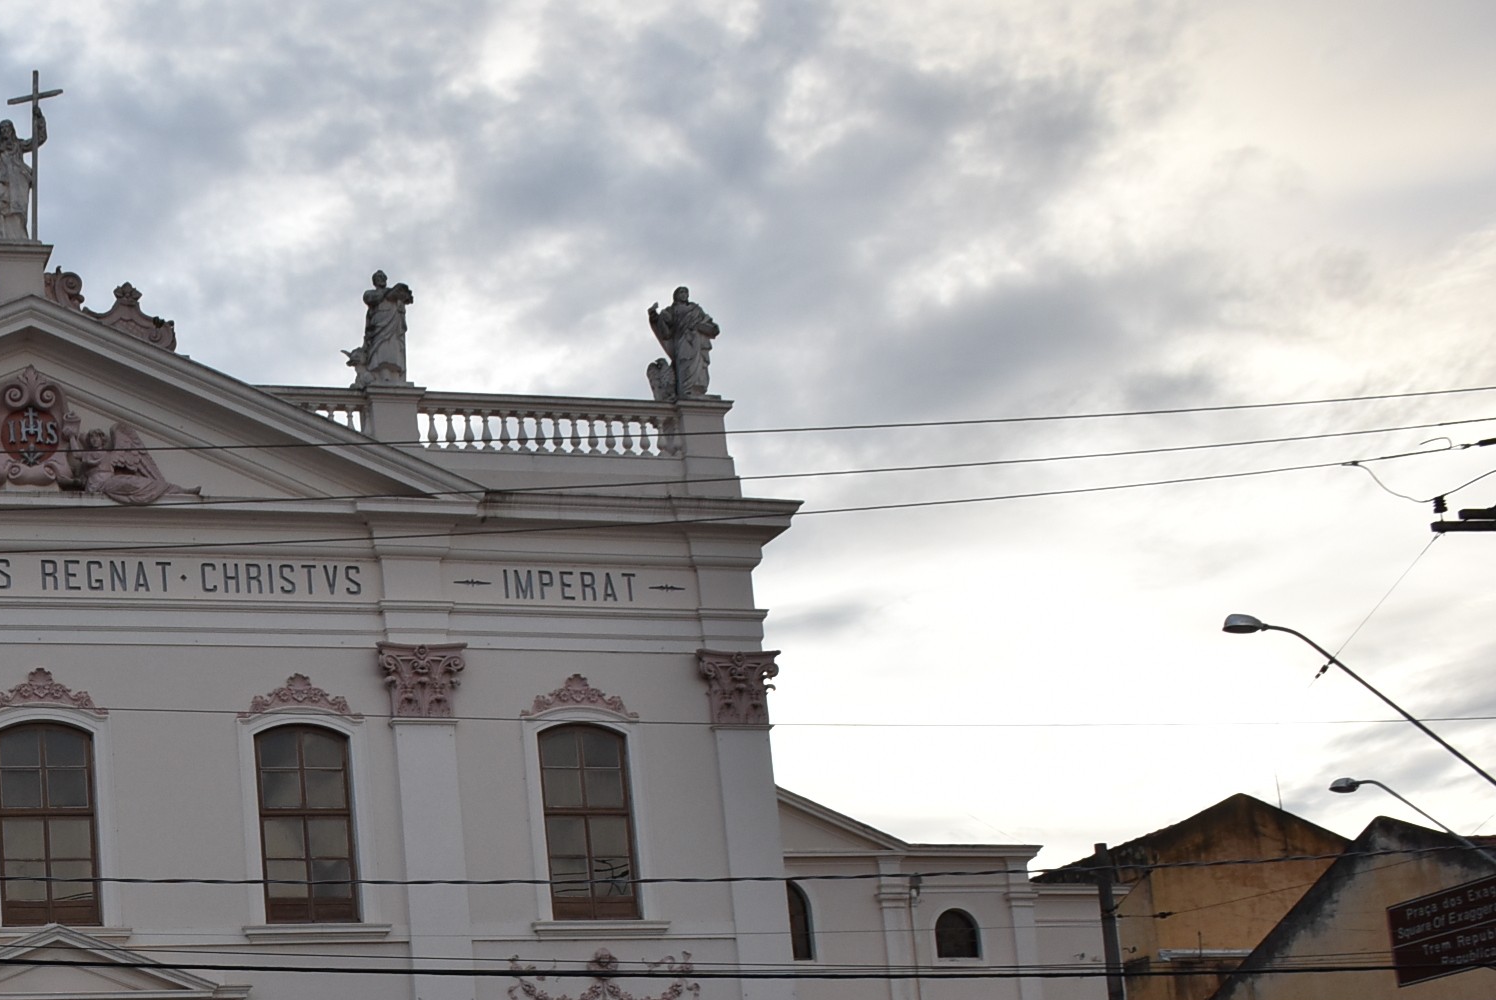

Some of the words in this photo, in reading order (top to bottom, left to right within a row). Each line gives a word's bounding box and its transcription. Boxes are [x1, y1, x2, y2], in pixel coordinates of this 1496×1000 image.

[7, 419, 59, 446] IHS
[40, 559, 172, 592] REGNAT
[199, 562, 363, 596] CHRISTVS
[502, 568, 637, 602] IMPERAT
[1406, 903, 1438, 920] Praça
[1442, 896, 1464, 909] dos
[1397, 922, 1432, 939] Square
[1421, 941, 1452, 956] Trem
